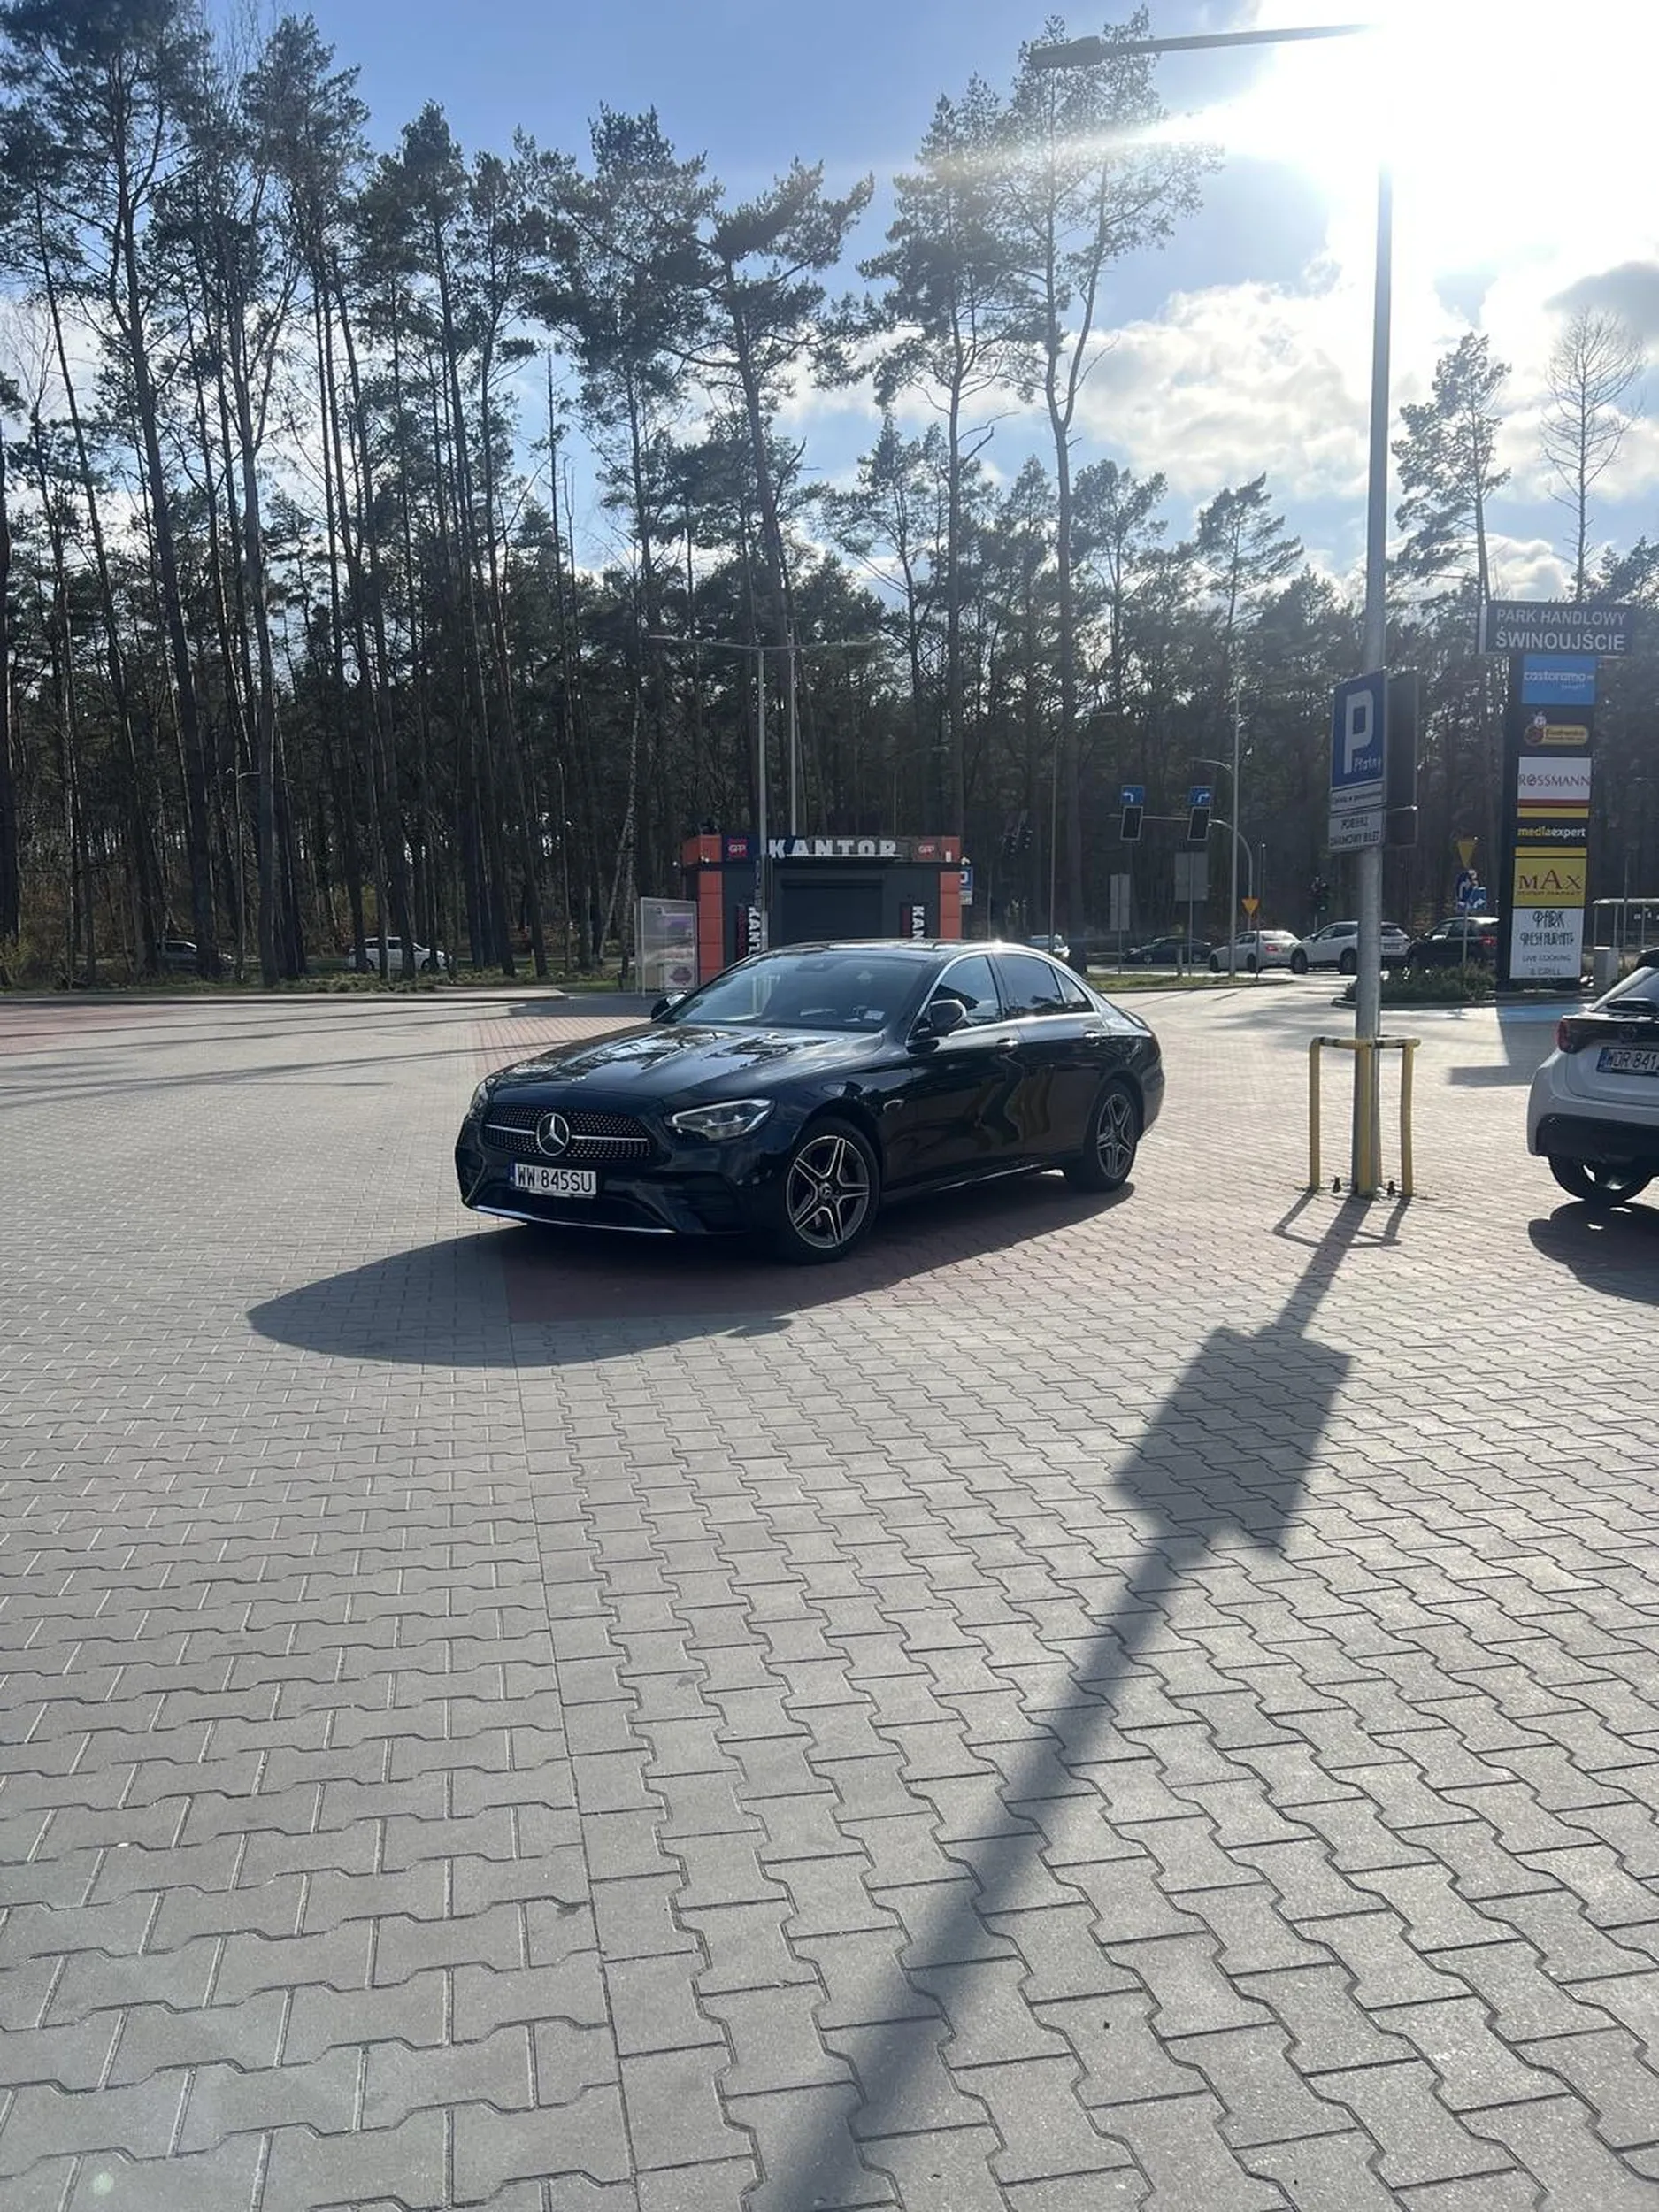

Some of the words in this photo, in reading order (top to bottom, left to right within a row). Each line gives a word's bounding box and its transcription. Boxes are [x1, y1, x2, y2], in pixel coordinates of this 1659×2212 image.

[1496, 609, 1538, 623] PARK
[1540, 611, 1627, 626] HANDLOWY
[1495, 626, 1626, 651] ŚWINOUJŚCIE
[1343, 689, 1374, 775] P
[1518, 775, 1591, 787] ROSSMANN
[769, 839, 897, 858] KANTOR
[1518, 869, 1582, 890] MAX
[1632, 1052, 1659, 1071] 841
[518, 1166, 536, 1187] WW
[541, 1169, 593, 1193] 845SU
